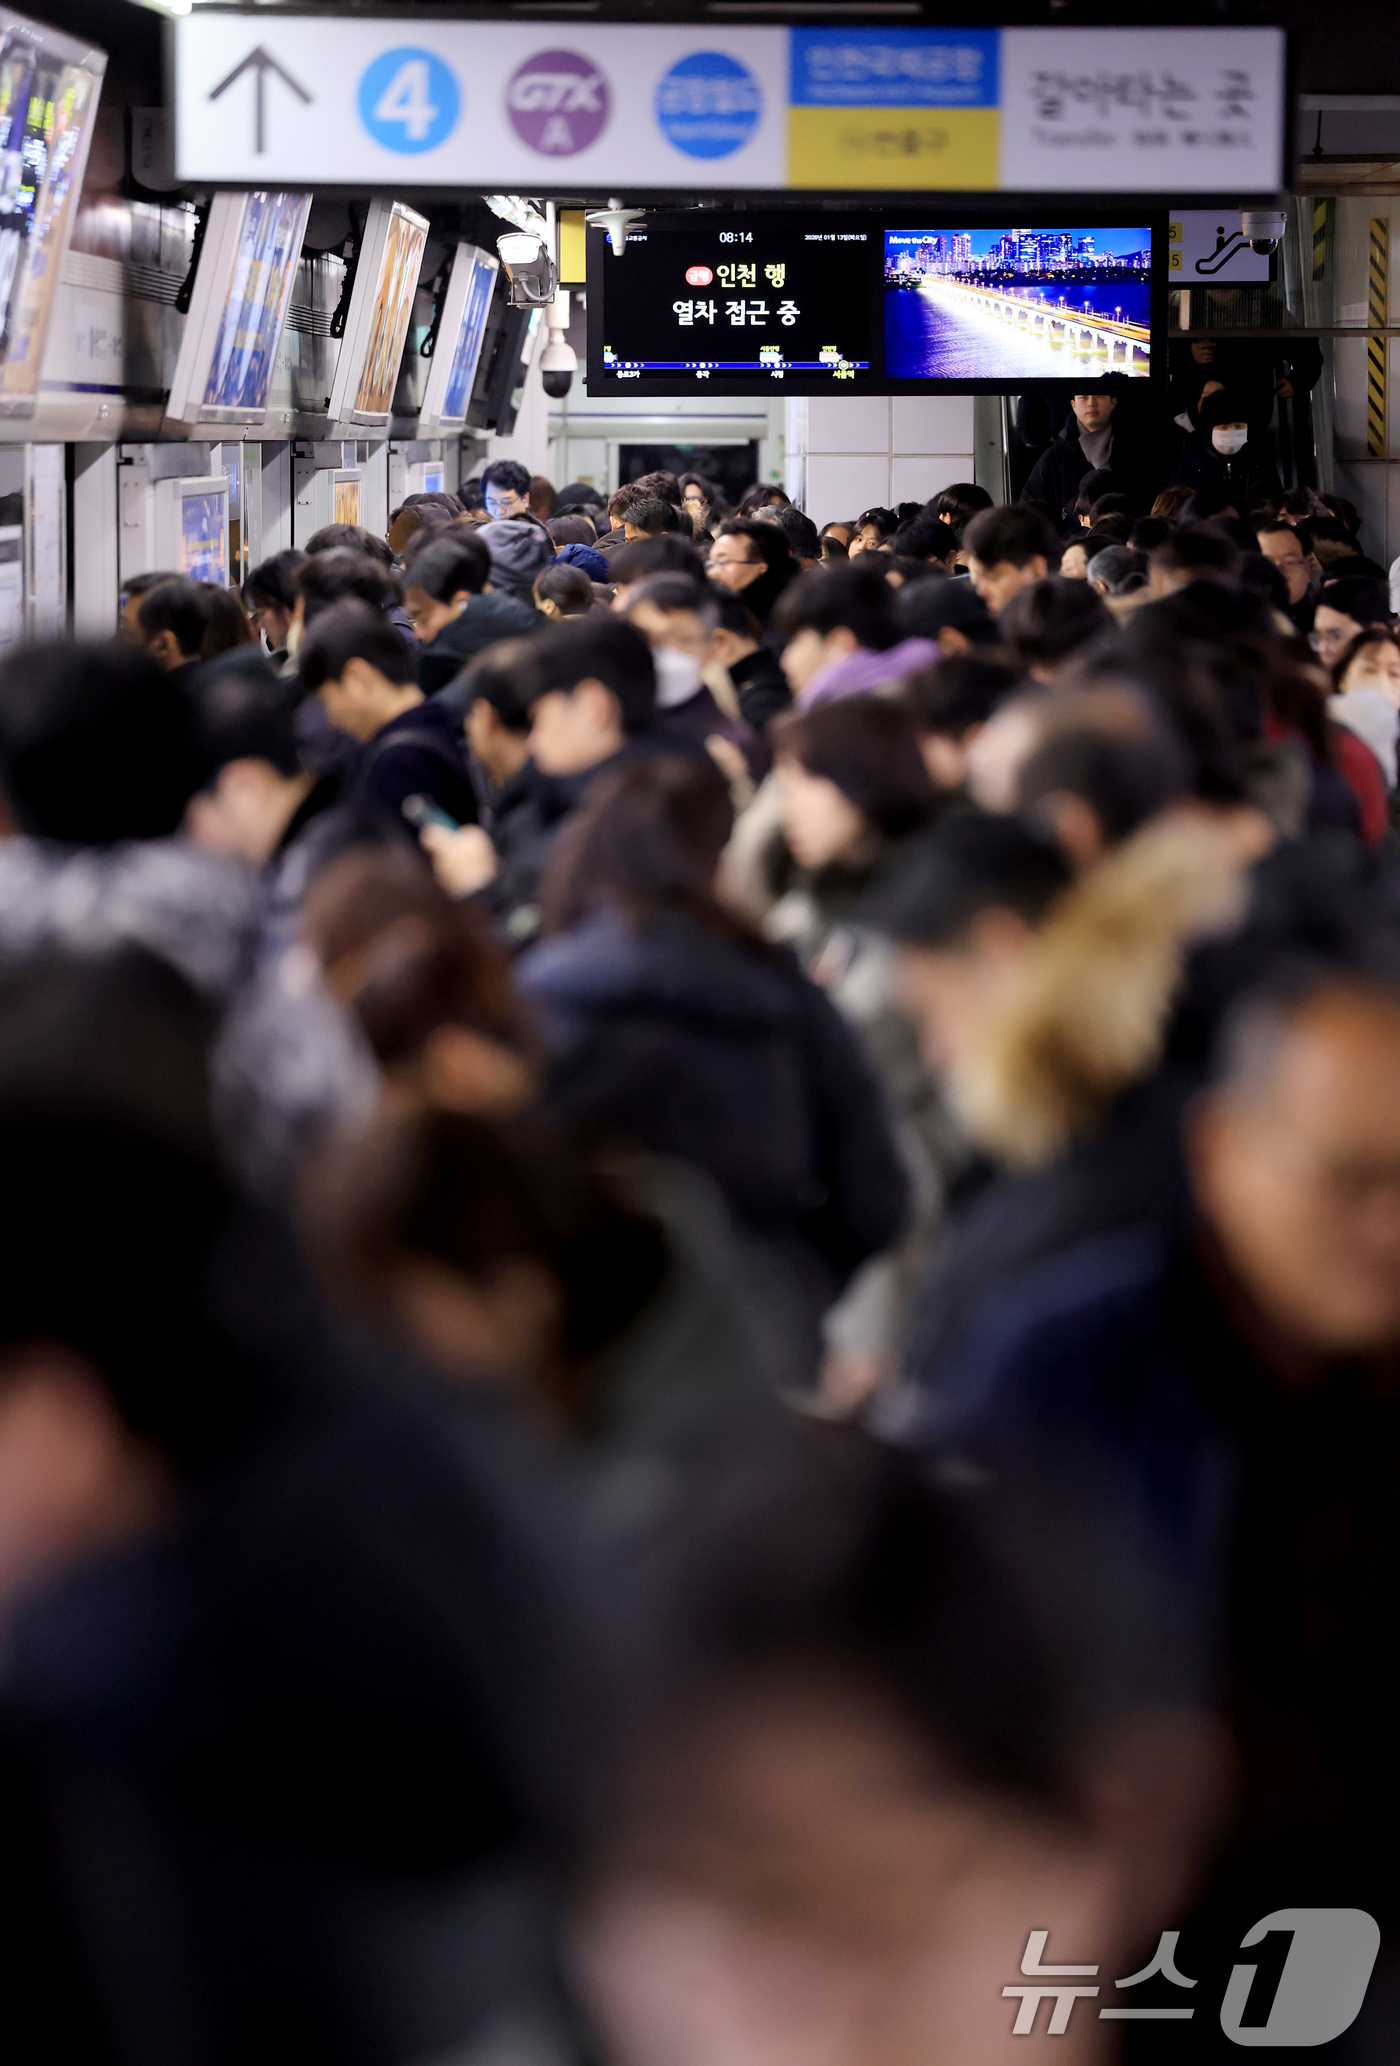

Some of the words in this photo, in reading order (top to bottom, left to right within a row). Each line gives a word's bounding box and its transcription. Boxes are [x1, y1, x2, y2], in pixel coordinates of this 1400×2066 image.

[372, 58, 440, 141] 4
[508, 71, 608, 113] GTX
[537, 113, 576, 150] A
[719, 232, 754, 243] 08:14
[889, 236, 912, 244] Move
[922, 236, 938, 244] City
[716, 263, 757, 288] 인천
[764, 263, 786, 288] 행
[672, 299, 719, 326] 열차
[725, 299, 770, 326] 접근
[776, 300, 801, 326] 중
[616, 370, 641, 379] 종로3가
[770, 370, 784, 379] 시청
[832, 370, 855, 379] 서울역
